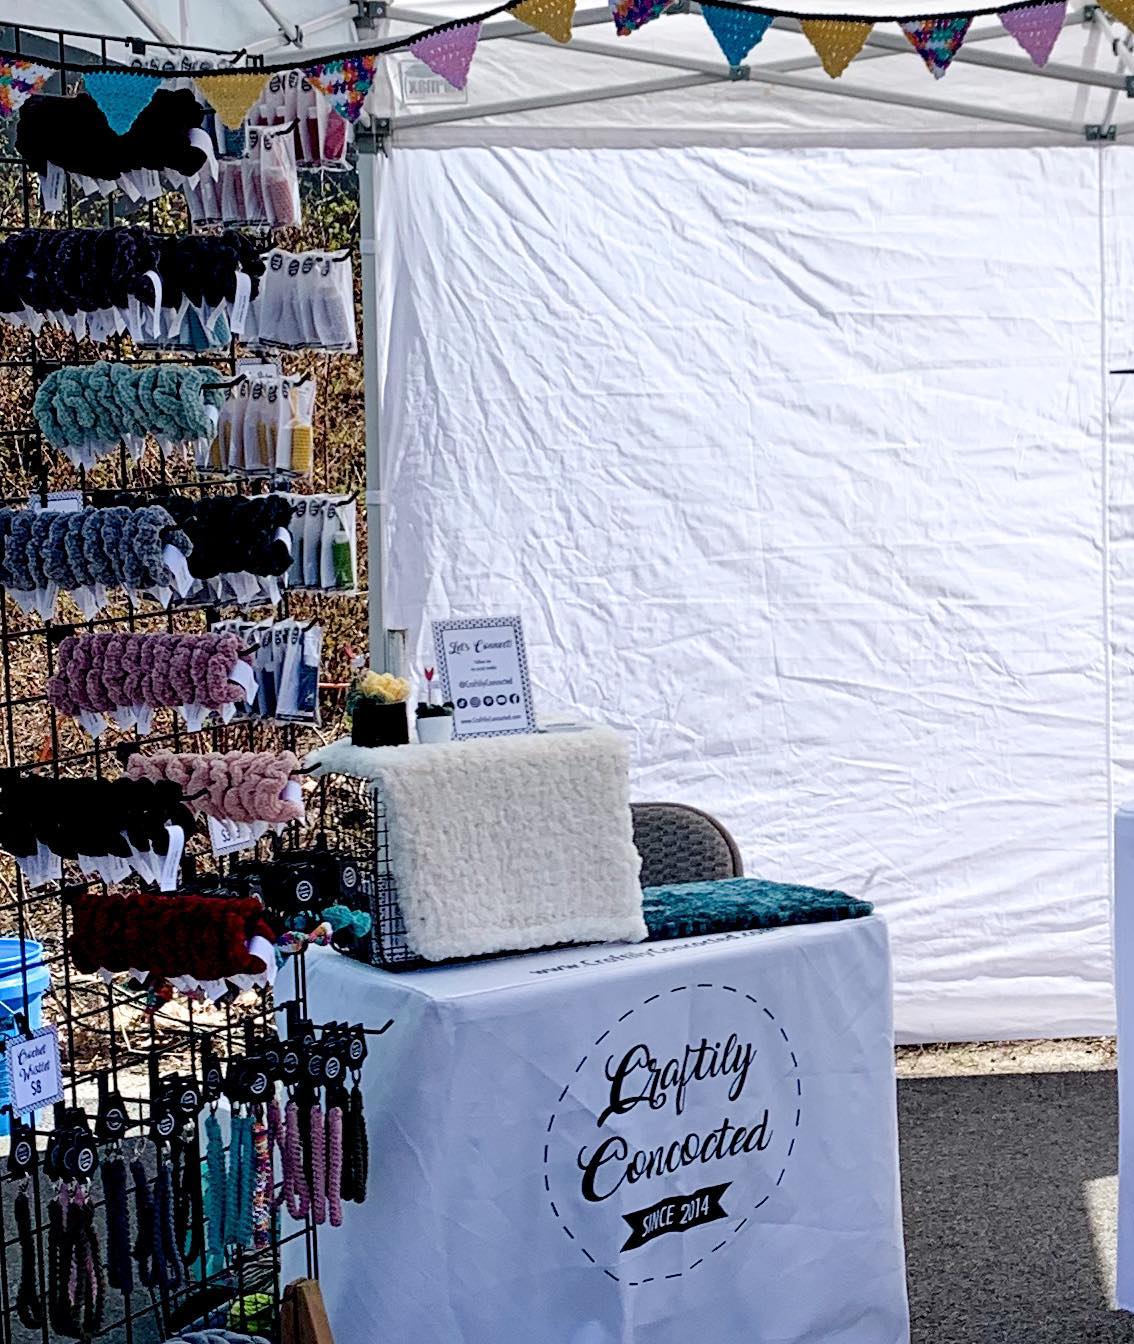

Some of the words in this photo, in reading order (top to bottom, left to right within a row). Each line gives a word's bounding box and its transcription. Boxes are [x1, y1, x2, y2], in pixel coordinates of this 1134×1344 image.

[596, 1033, 757, 1128] Craftily
[577, 1109, 774, 1203] Concocted
[641, 1204, 674, 1237] SINCE
[680, 1195, 709, 1225] 2014
